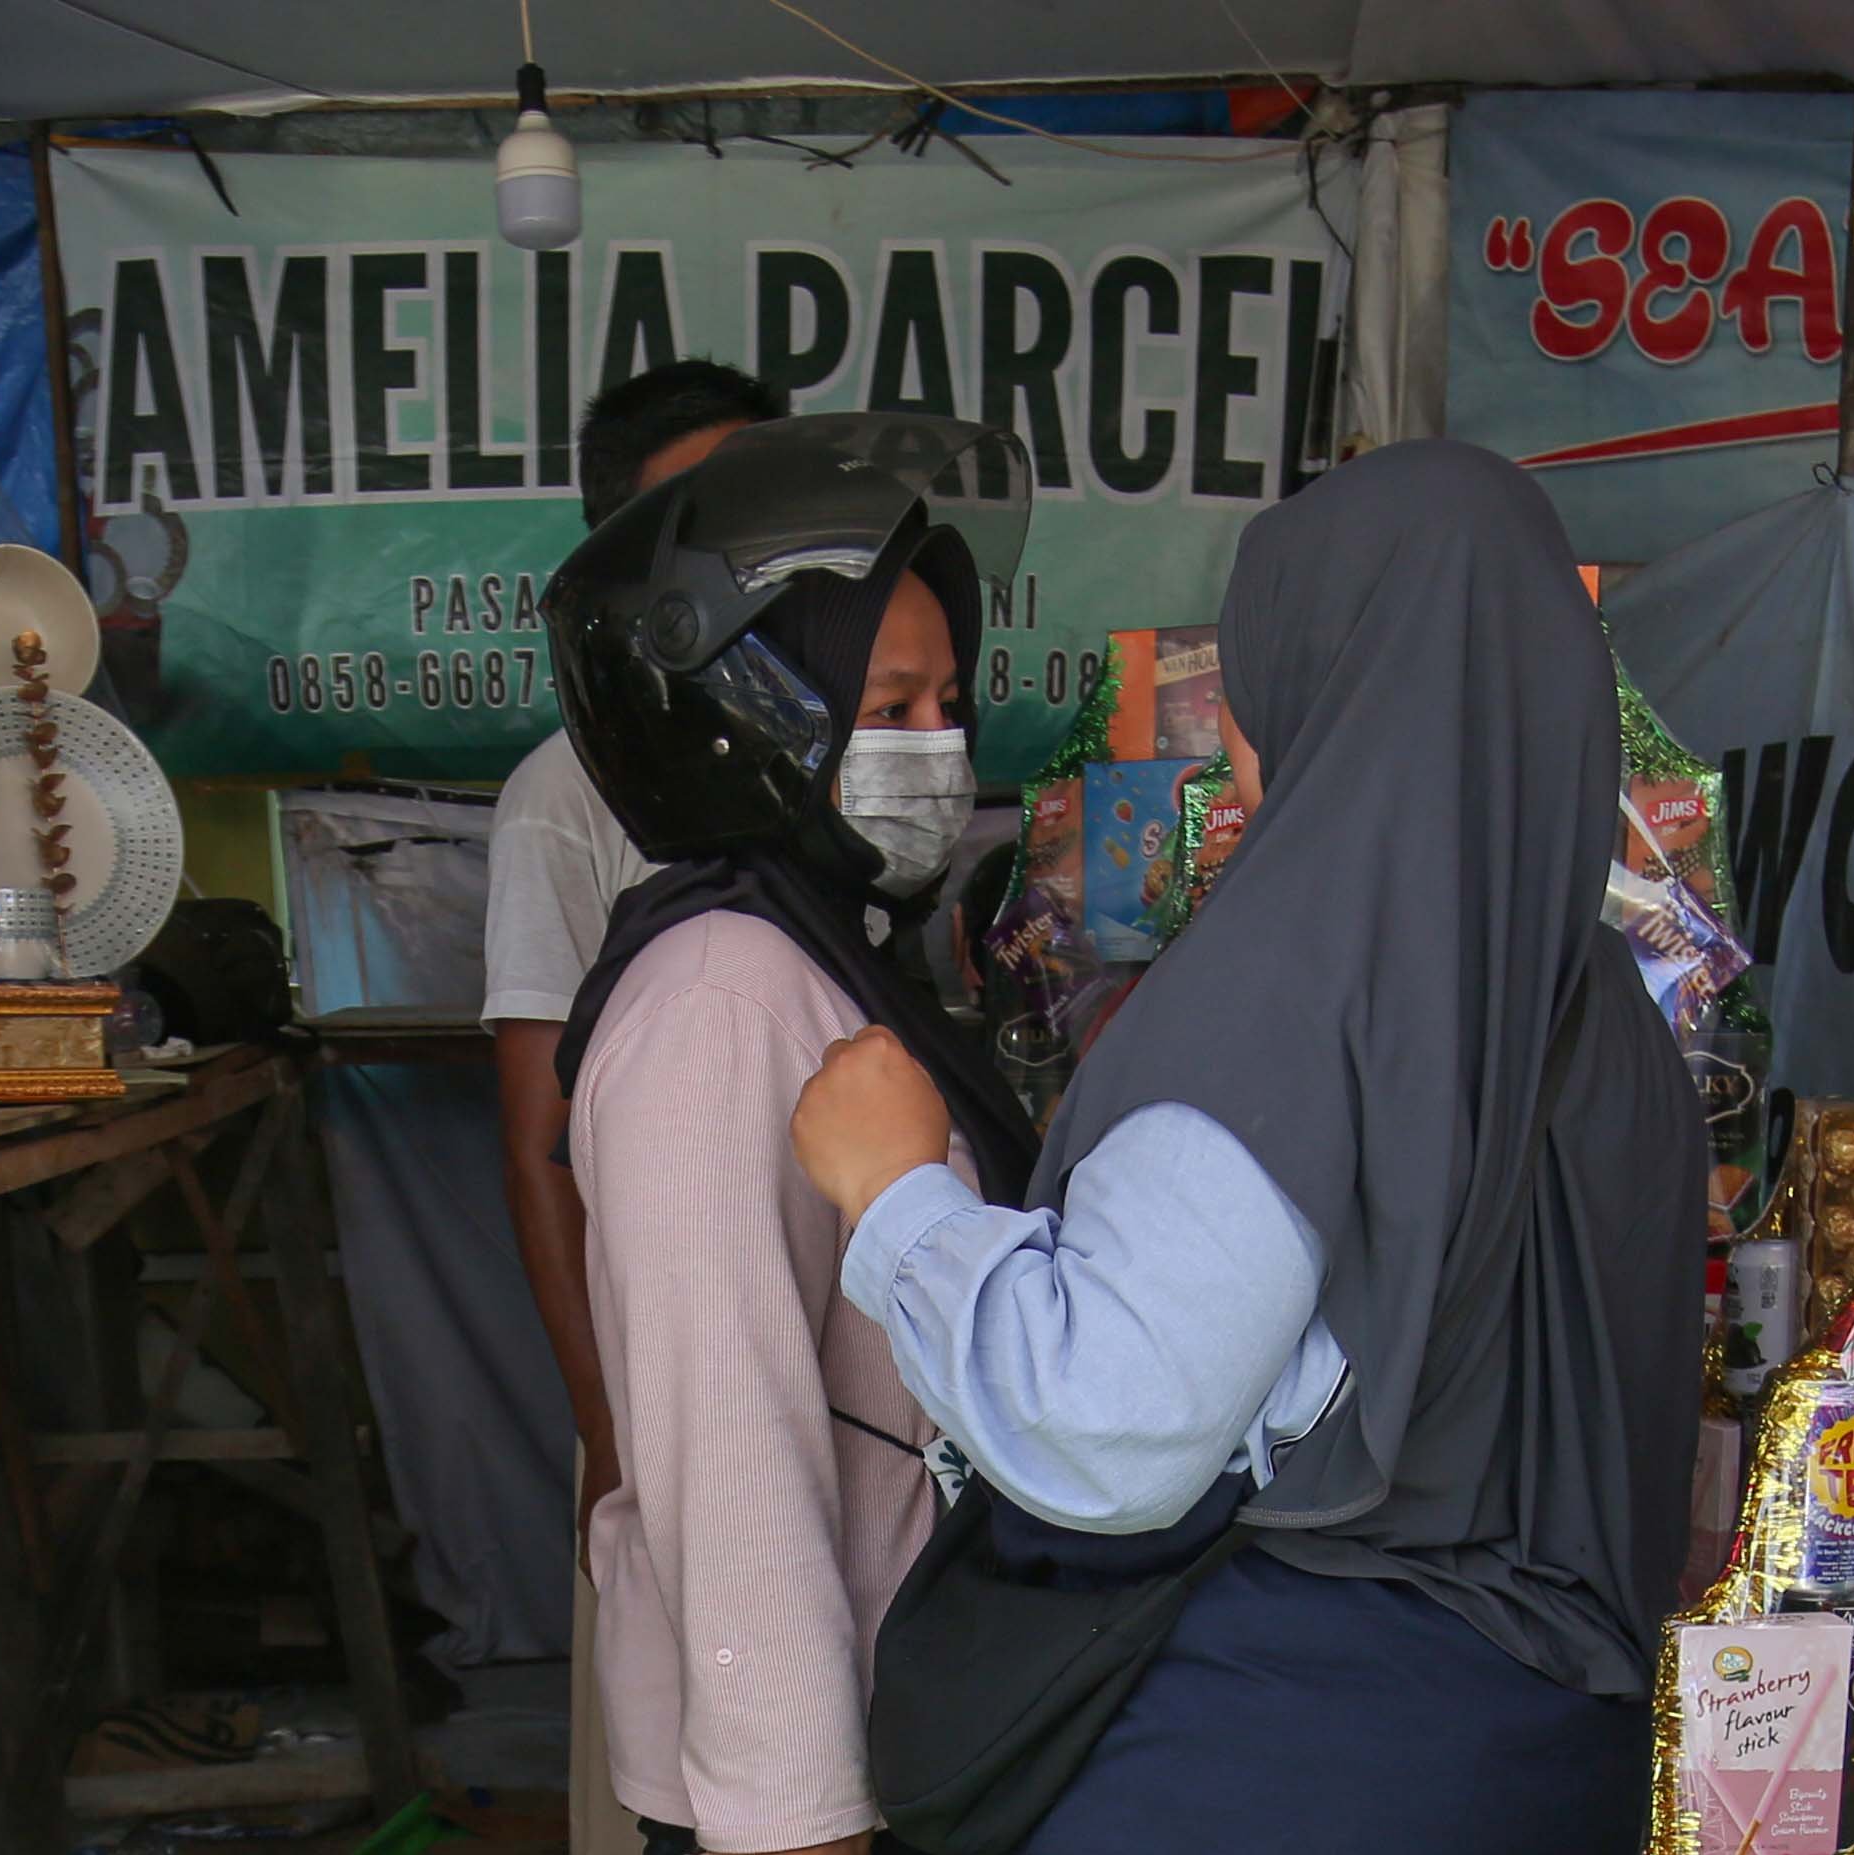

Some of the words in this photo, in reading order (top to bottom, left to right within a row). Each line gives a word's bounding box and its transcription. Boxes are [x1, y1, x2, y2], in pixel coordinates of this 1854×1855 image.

[98, 244, 684, 506] AMELIA
[409, 573, 554, 635] PASA
[1696, 1666, 1813, 1719] Strawberry
[1724, 1704, 1798, 1746] flavour
[1735, 1729, 1781, 1759] stick
